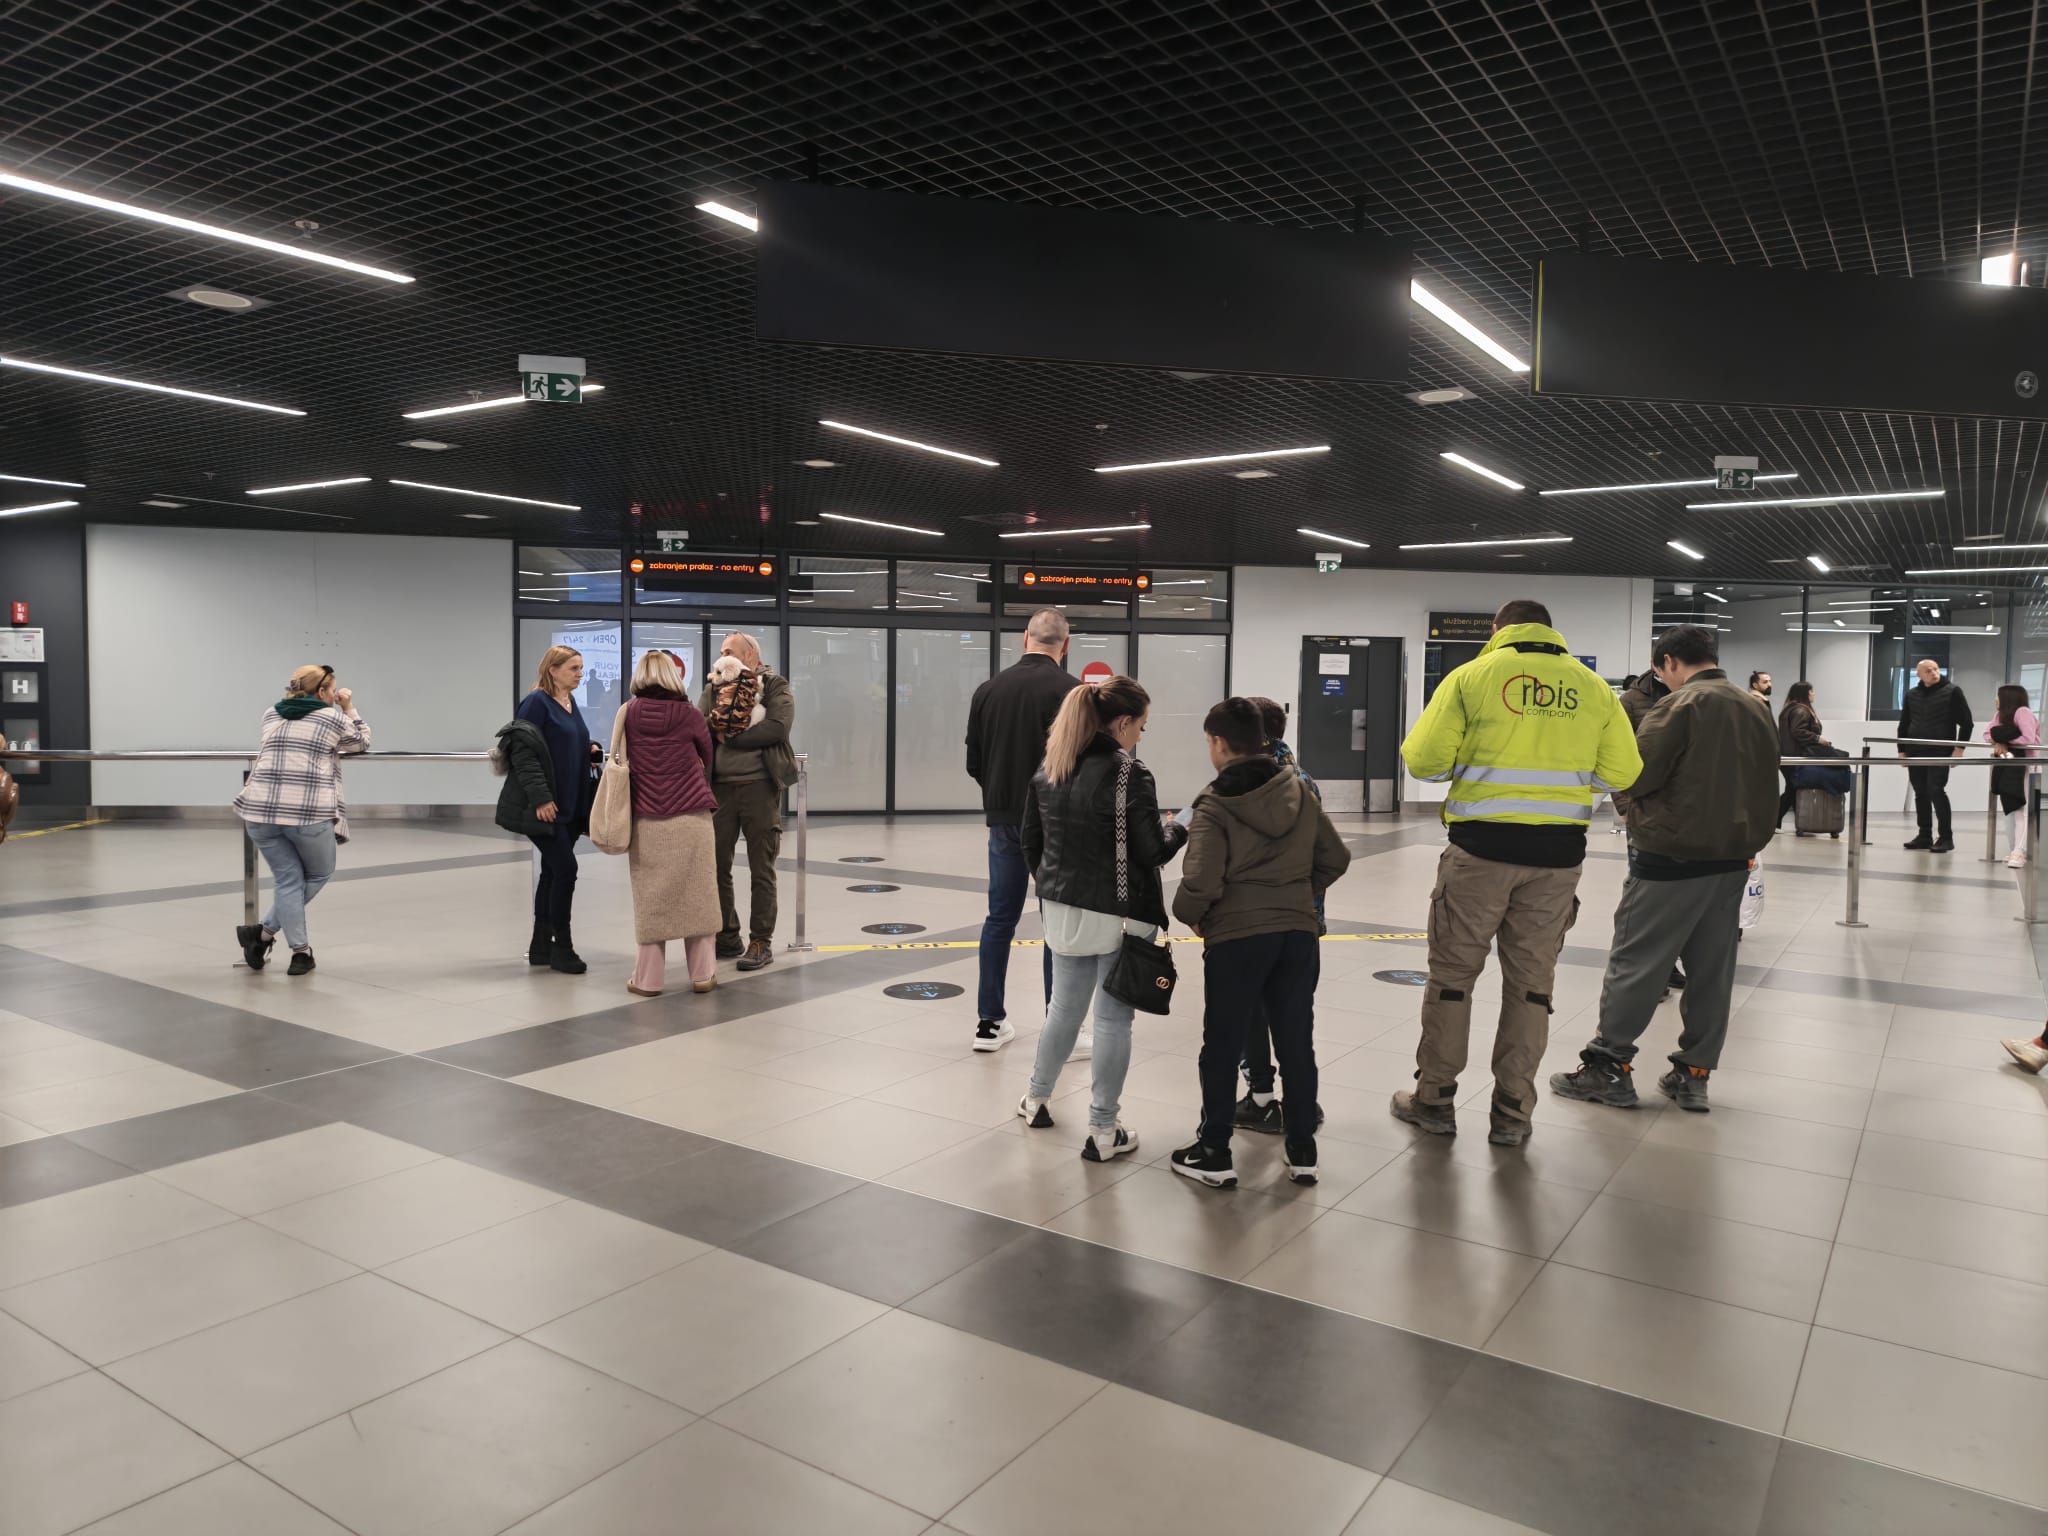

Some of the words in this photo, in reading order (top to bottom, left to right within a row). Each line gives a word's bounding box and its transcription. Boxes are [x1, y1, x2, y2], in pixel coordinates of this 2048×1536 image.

[649, 562, 687, 572] zabranjen
[689, 563, 713, 571] prolaz
[733, 564, 754, 573] entry
[1040, 576, 1074, 584] zabranjen
[1113, 577, 1132, 585] entry
[1473, 618, 1492, 626] prola
[1526, 708, 1577, 720] company
